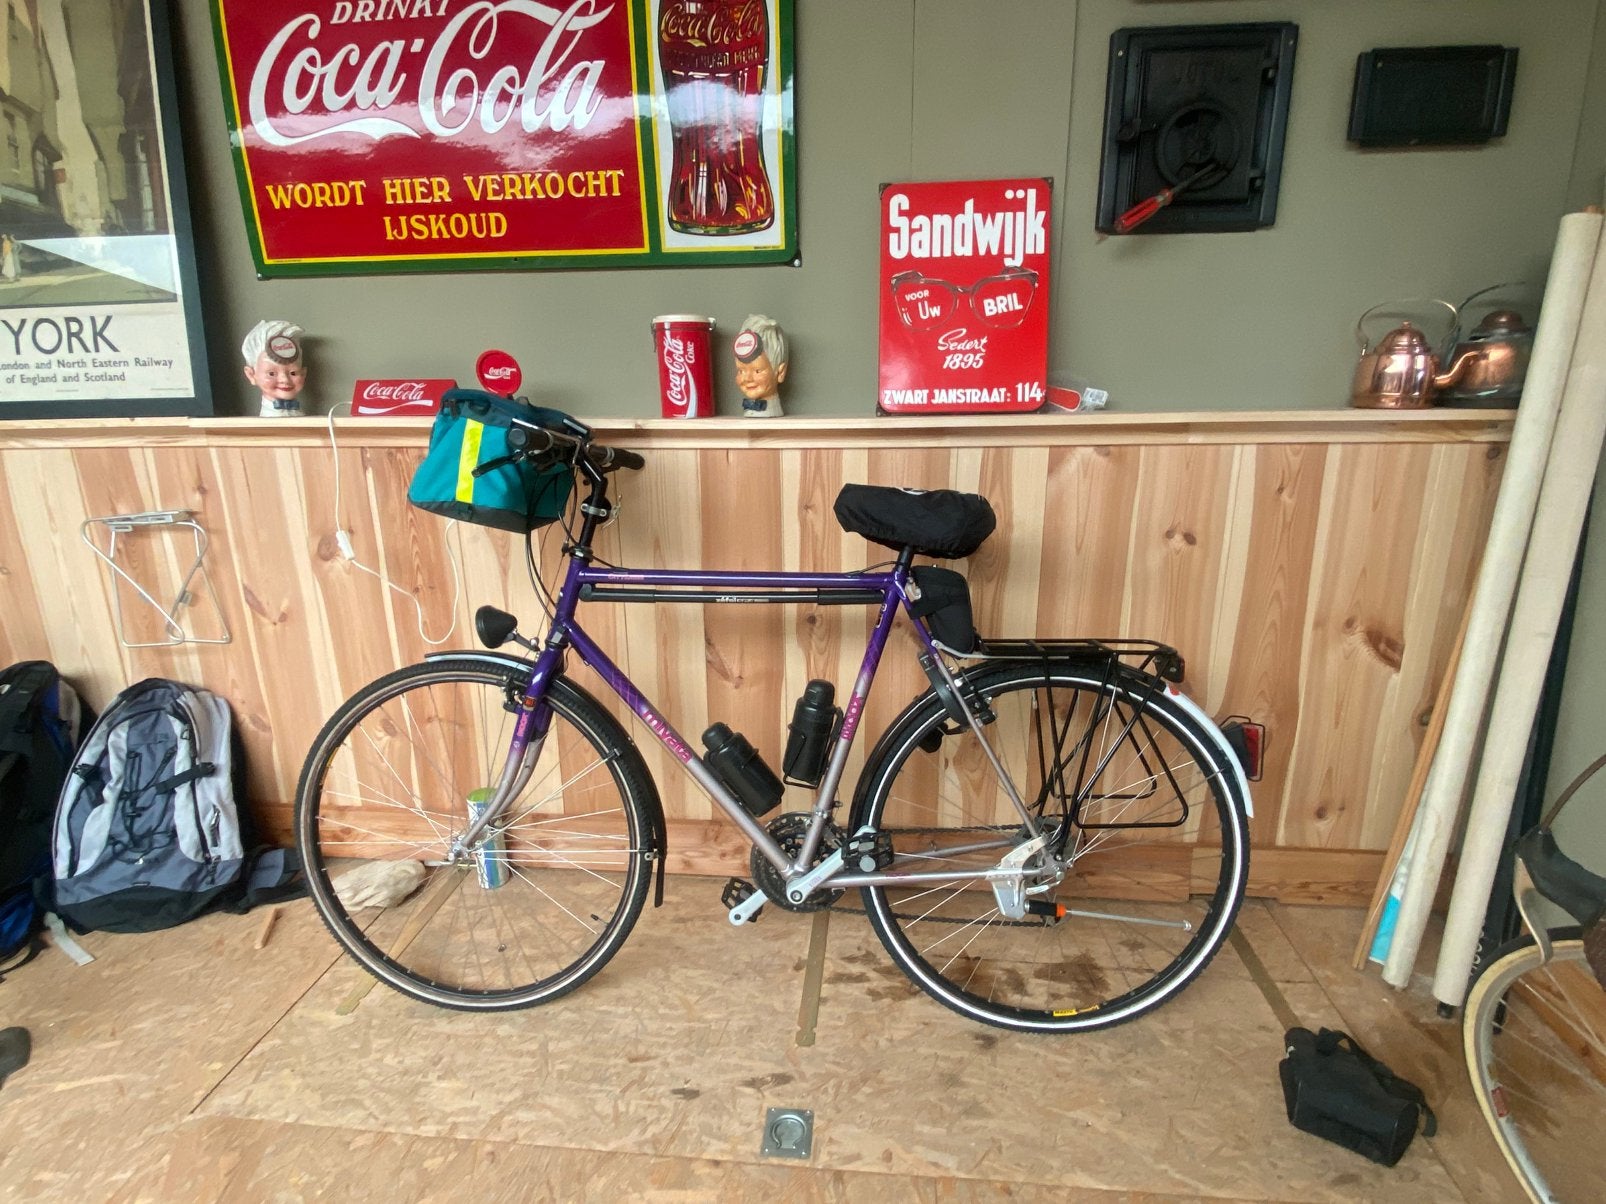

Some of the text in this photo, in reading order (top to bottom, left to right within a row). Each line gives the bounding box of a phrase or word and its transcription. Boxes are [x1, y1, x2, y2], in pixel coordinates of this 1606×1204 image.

[248, 0, 615, 146] Coca-Cola
[266, 170, 625, 209] WORDT HIER VERKOCHT
[384, 212, 508, 240] IJSKOUD
[889, 188, 1046, 267] Sandwijk
[905, 290, 930, 302] VOOR
[983, 293, 1023, 317] BRIL
[1, 315, 120, 355] YORK
[937, 328, 988, 352] Sedert
[35, 360, 52, 370] and
[57, 358, 87, 369] North
[92, 357, 129, 368] Eastern
[134, 357, 174, 369] Railway
[664, 335, 688, 406] Coca-Cola
[942, 353, 985, 369] 1895
[6, 372, 126, 386] of England and Scotland
[363, 382, 427, 401] Coca-Cola
[883, 389, 929, 405] ZWART
[931, 388, 1011, 404] JANSTRAAT:
